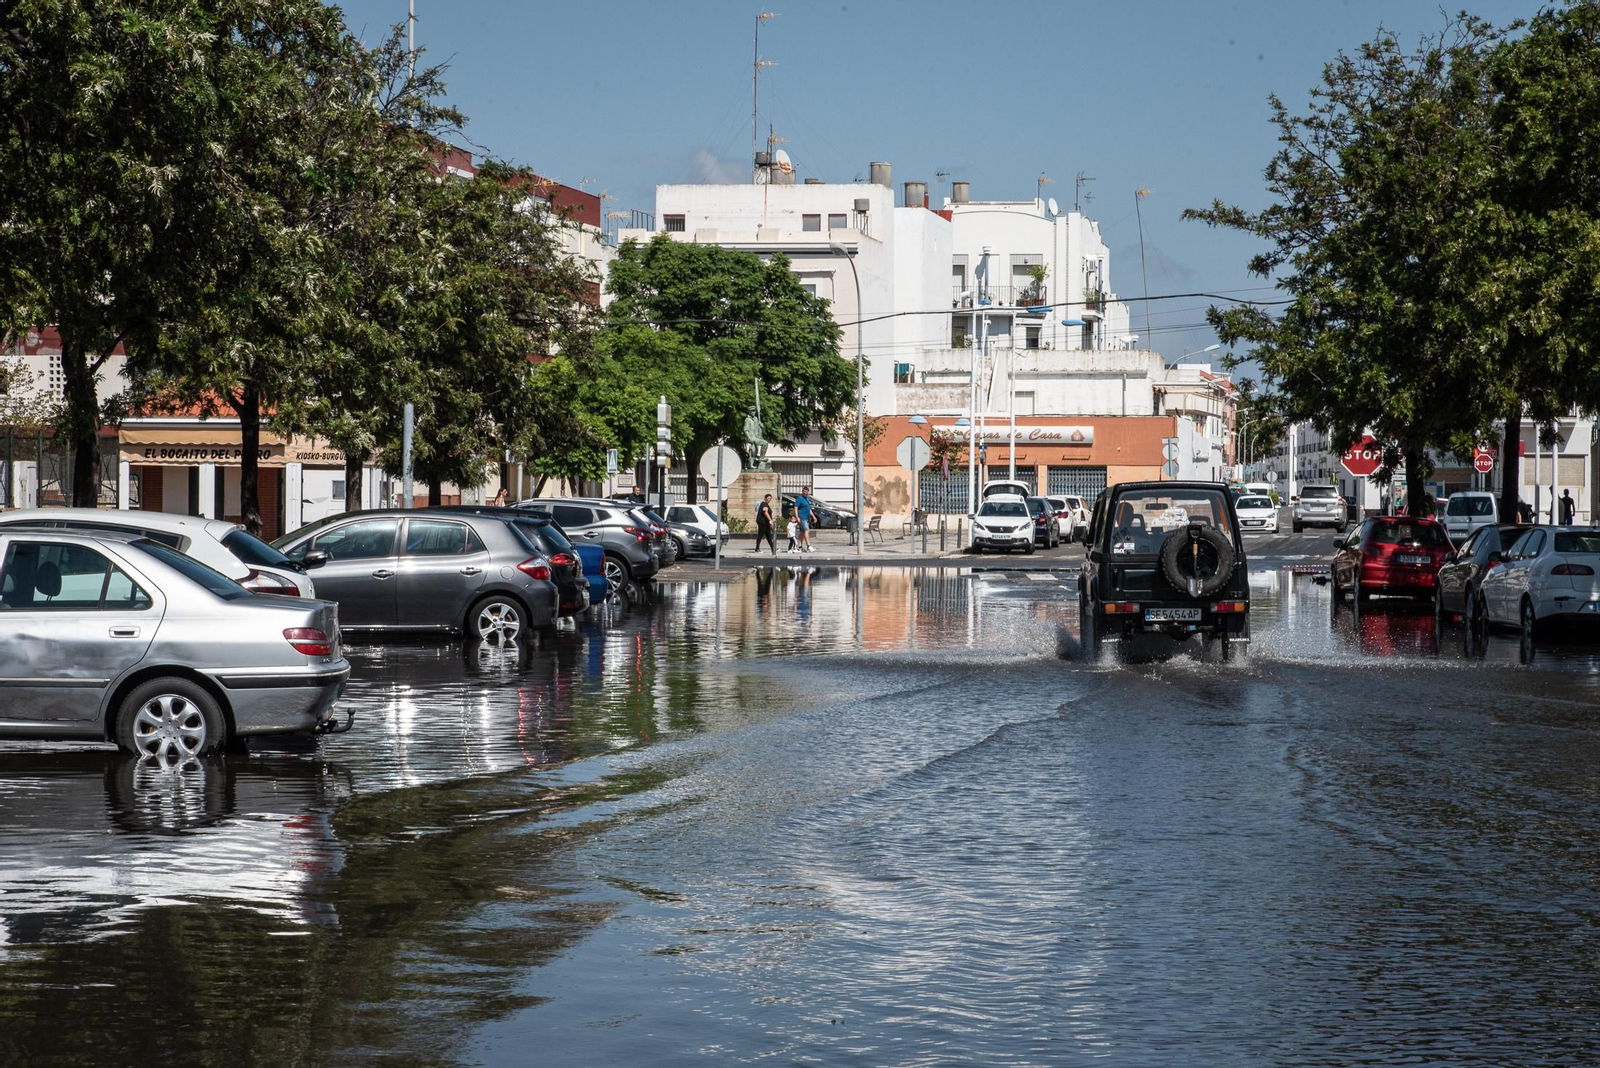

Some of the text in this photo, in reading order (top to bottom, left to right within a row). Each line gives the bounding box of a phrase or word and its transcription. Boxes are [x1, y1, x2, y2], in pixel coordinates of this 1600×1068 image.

[1028, 428, 1063, 440] Casa
[144, 449, 271, 460] EL BOCAITO DEL PRO
[1344, 449, 1381, 460] STOP
